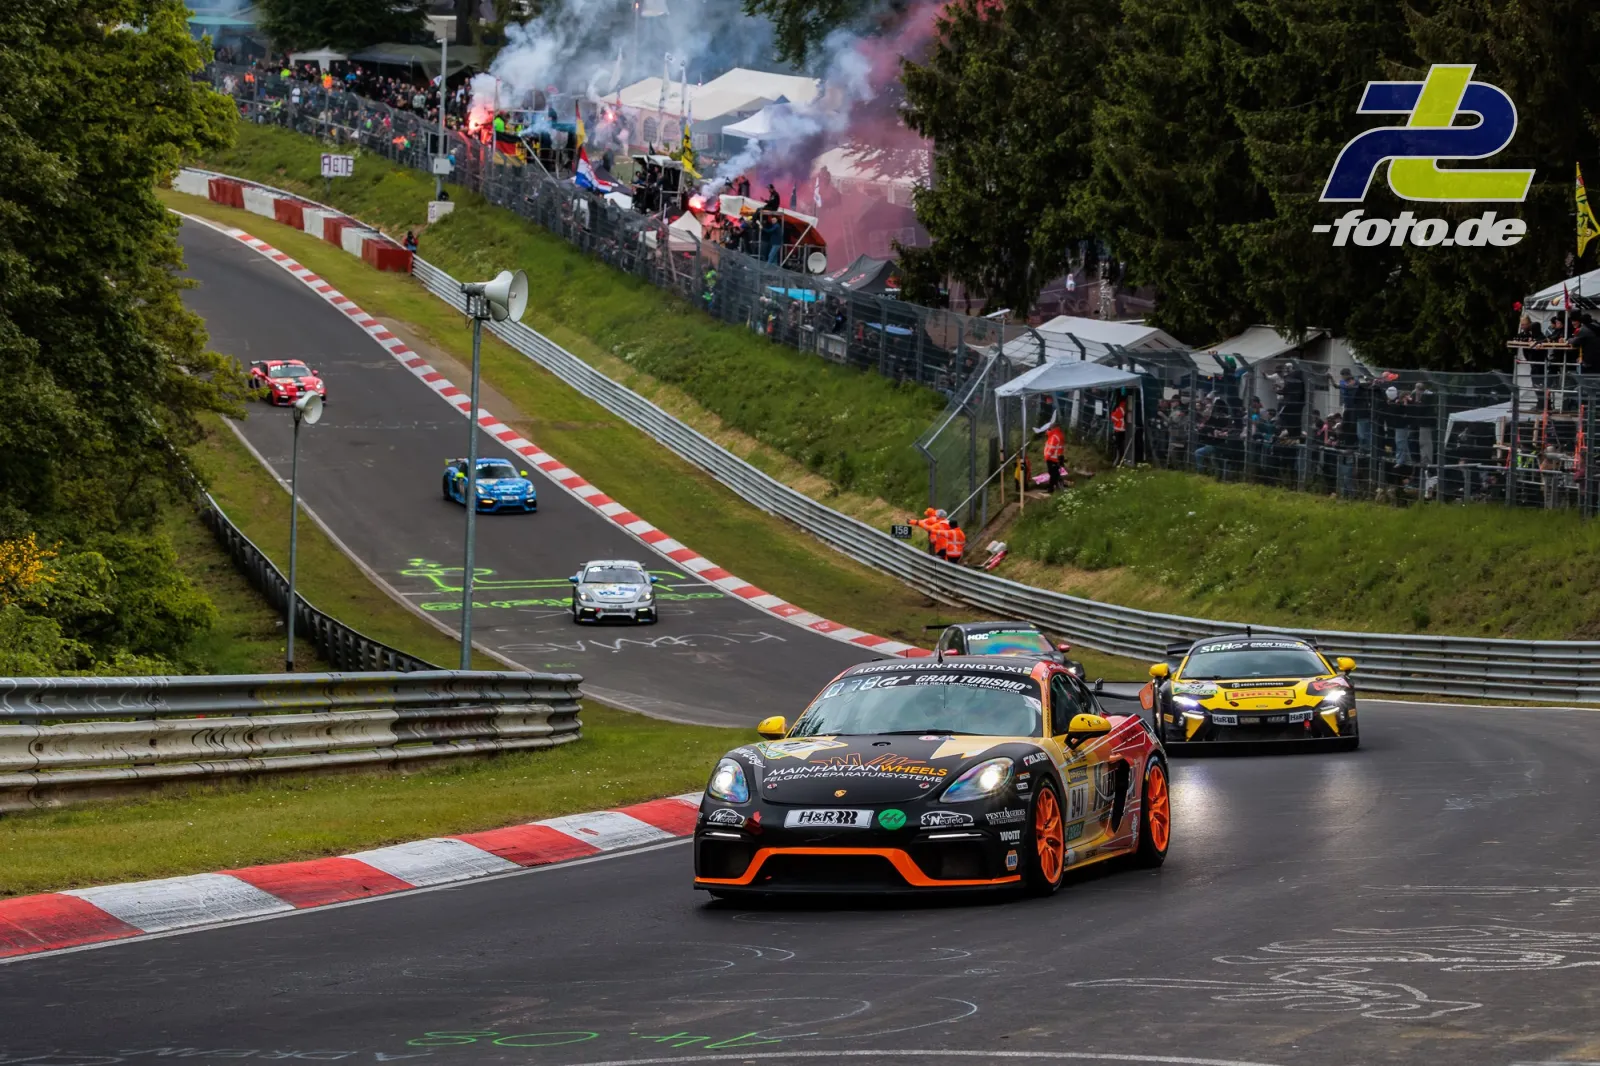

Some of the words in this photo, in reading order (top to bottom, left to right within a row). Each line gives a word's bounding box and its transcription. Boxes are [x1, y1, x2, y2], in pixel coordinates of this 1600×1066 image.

[895, 525, 909, 535] 158
[853, 663, 1021, 675] ADRENALIN-RINGTAXI
[980, 685, 1020, 694] SIMULATOR
[763, 771, 944, 783] FELGEN-REPARATURSYSTEME
[799, 811, 835, 824] H&R
